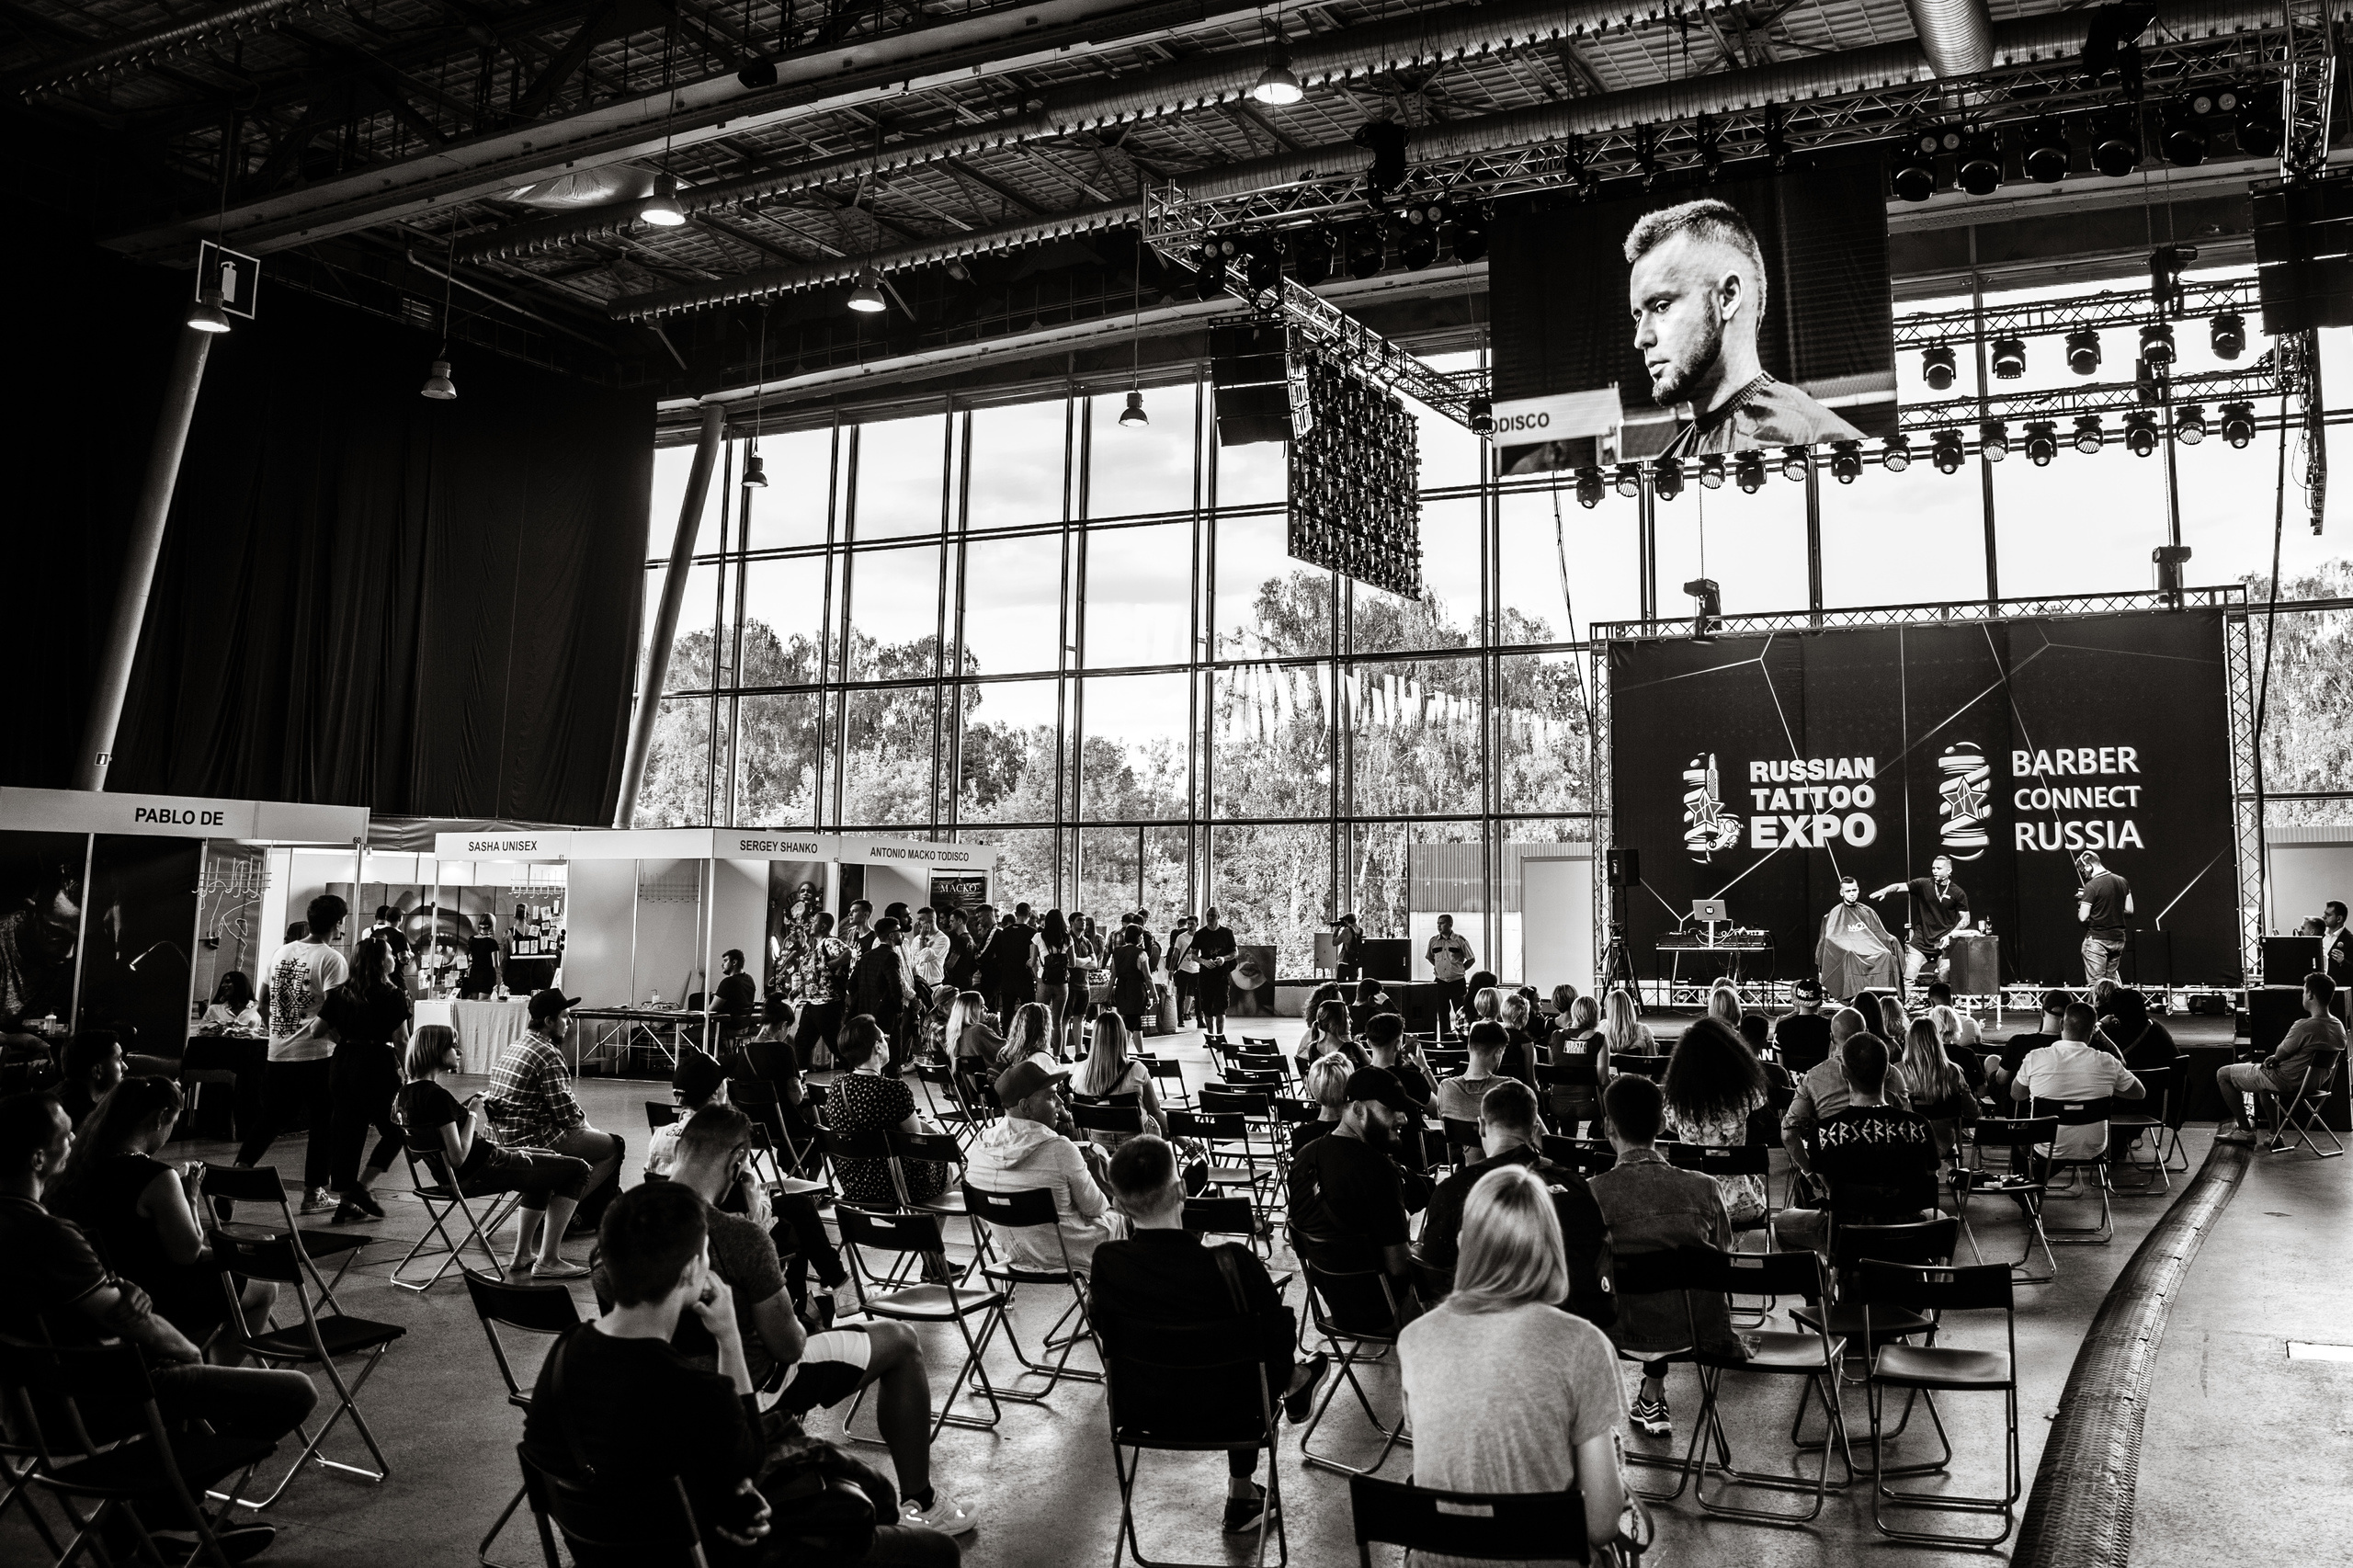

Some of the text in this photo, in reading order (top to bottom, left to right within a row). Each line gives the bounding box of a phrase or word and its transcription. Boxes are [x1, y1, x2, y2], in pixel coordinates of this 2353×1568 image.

[1749, 756, 1876, 782] RUSSIAN
[2012, 746, 2141, 777] BARBER
[1750, 784, 1876, 811] TATTOO
[2014, 785, 2143, 811] CONNECT
[134, 807, 224, 826] PABLO DE
[353, 836, 362, 845] 60
[1750, 812, 1877, 848] EXPO
[2015, 820, 2145, 851] RUSSIA
[468, 840, 538, 852] SASHA UNISEX
[740, 839, 818, 854] SERGEY SHANKO
[870, 846, 970, 862] ANTONIO MACKO TODISCO
[939, 883, 977, 893] MACKO
[1797, 987, 1814, 998] DOPE
[1818, 1119, 1927, 1151] BERSERKERS
